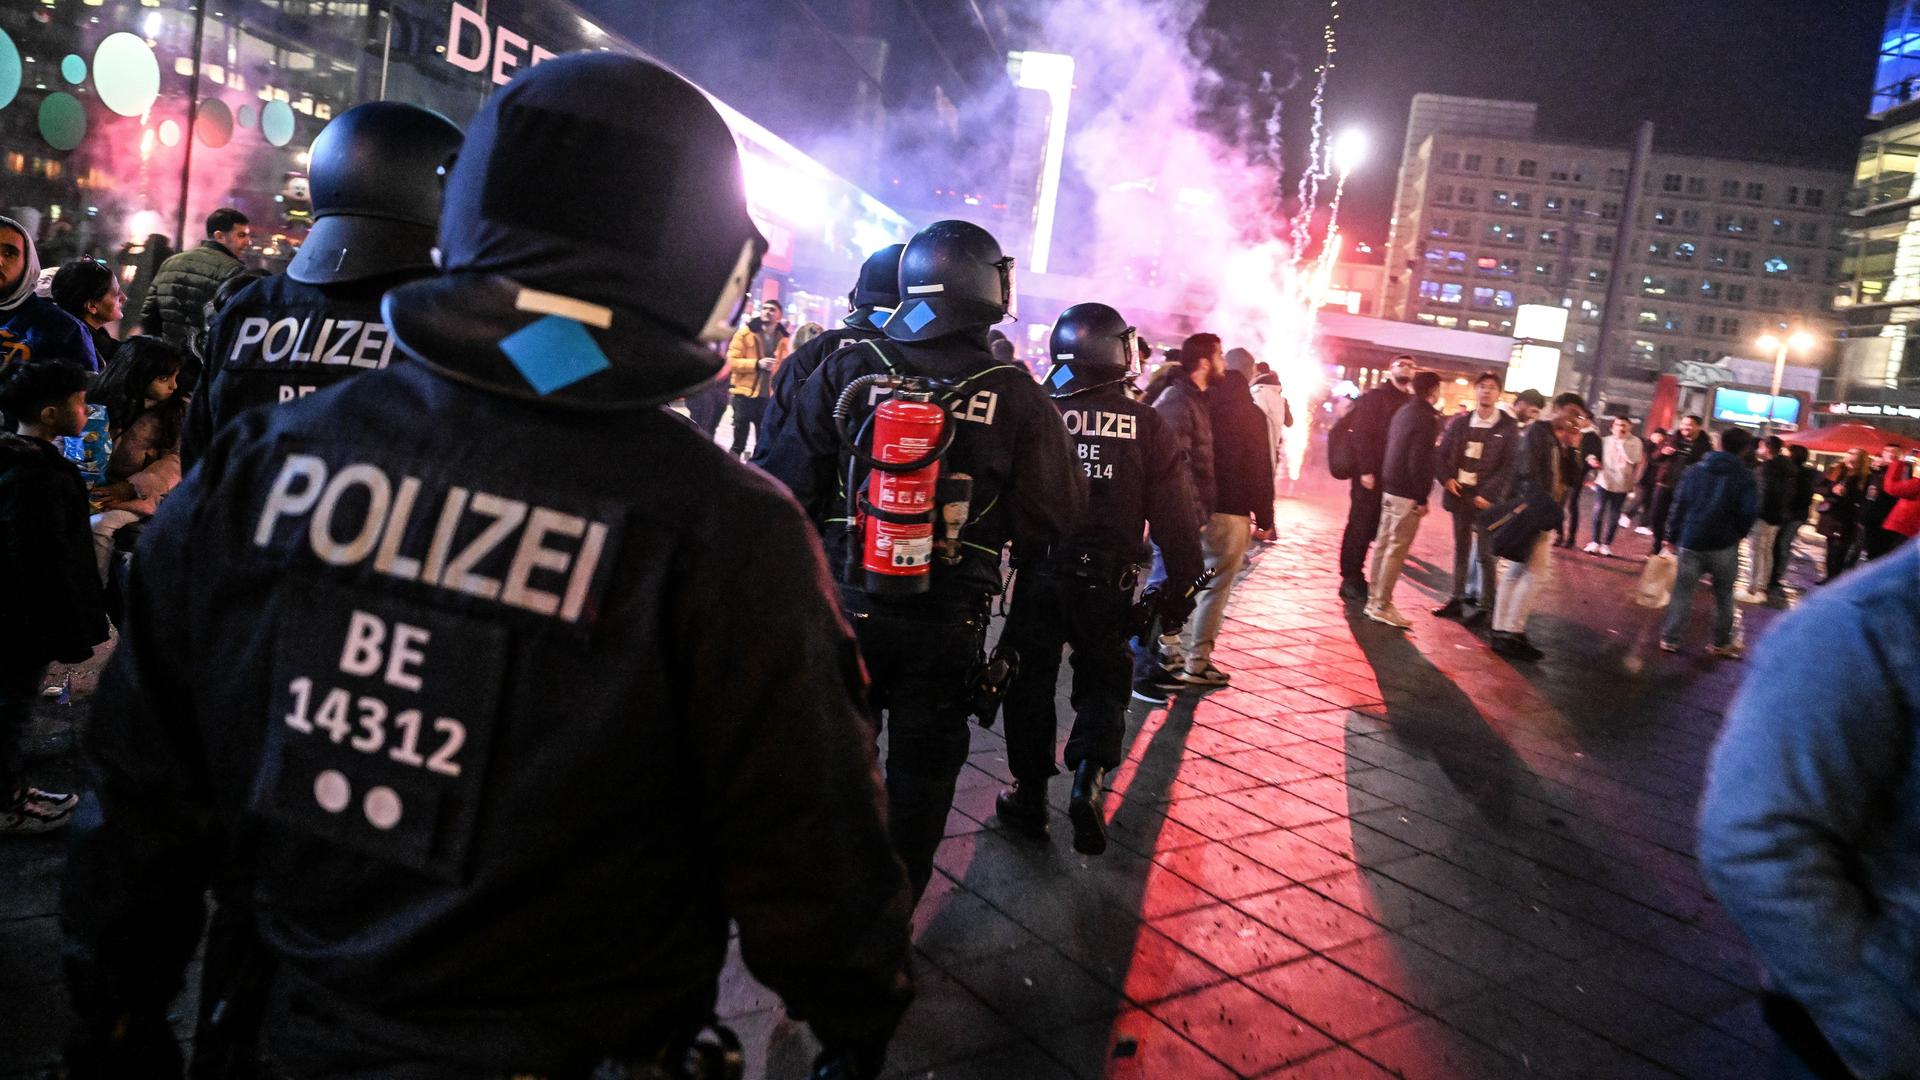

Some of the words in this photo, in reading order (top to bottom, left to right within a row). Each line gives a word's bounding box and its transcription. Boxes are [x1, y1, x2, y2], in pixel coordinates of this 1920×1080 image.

[229, 316, 396, 370] POLIZEI
[1062, 409, 1137, 440] OLIZEI
[1077, 443, 1101, 460] BE
[1082, 462, 1113, 479] 314
[253, 453, 609, 623] POLIZEI
[338, 609, 432, 692] BE
[284, 675, 467, 777] 14312
